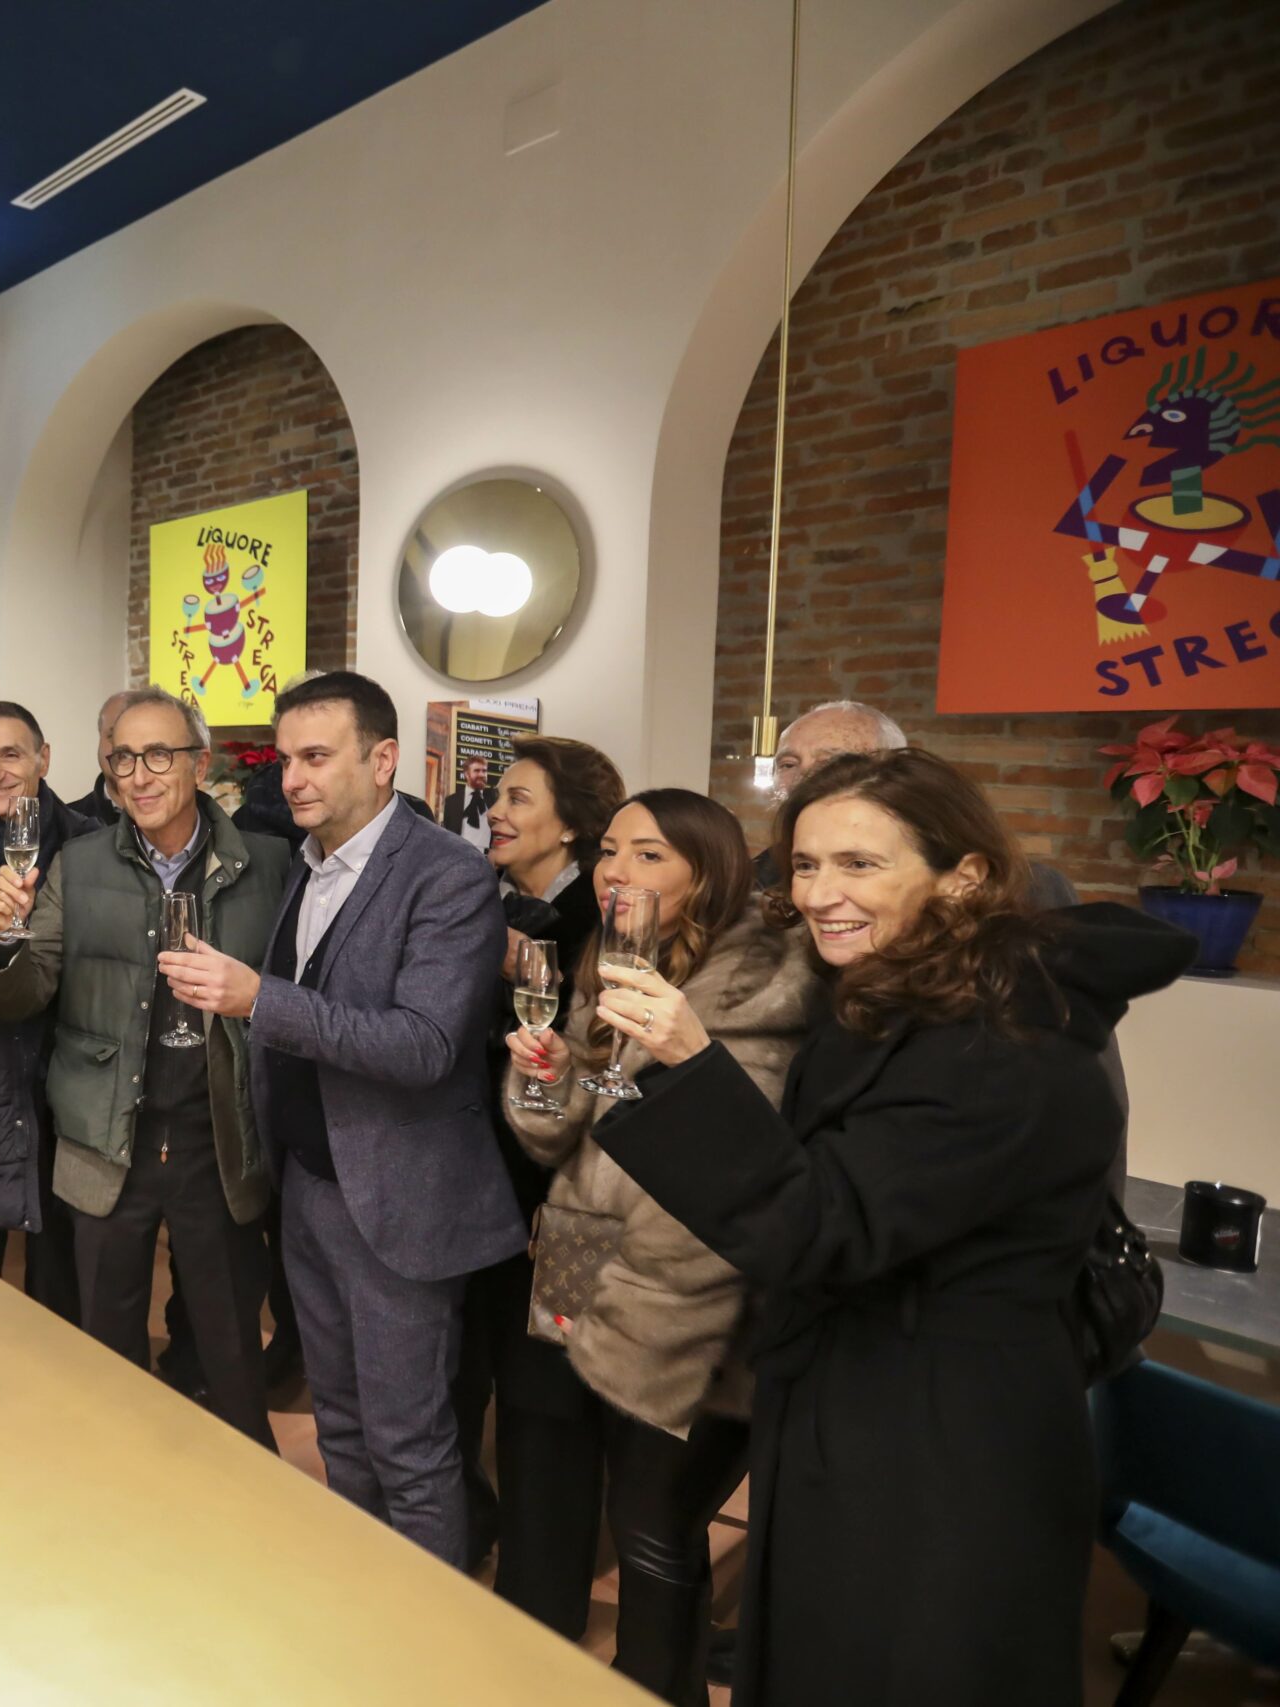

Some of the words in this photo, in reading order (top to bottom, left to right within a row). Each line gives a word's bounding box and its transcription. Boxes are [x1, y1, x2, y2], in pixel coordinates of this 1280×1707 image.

[247, 609, 277, 695] STREGA
[1096, 609, 1280, 696] STRE
[460, 722, 489, 732] CIABATTI
[460, 735, 493, 745] COGNETTI
[460, 747, 493, 758] MARASCO
